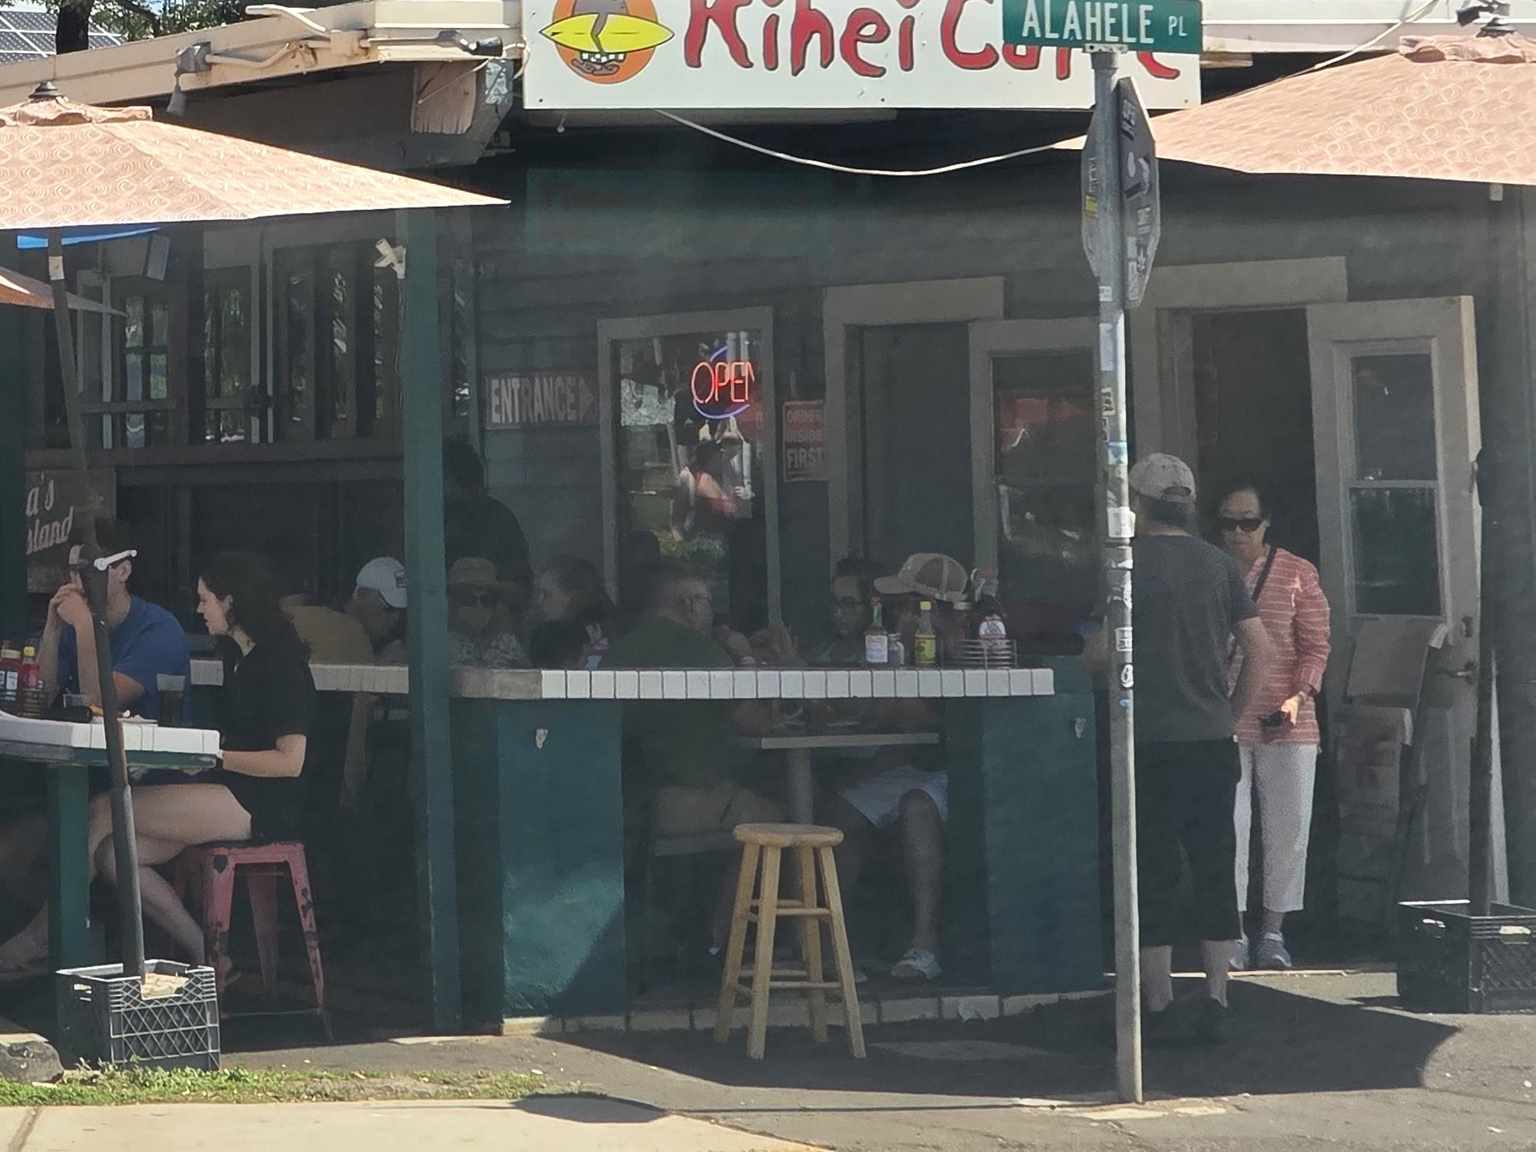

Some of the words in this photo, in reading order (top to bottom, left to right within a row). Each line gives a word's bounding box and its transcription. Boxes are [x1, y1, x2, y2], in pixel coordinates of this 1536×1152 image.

[1168, 14, 1188, 37] PL
[491, 376, 577, 425] ENTRANCE
[25, 506, 75, 555] sland
